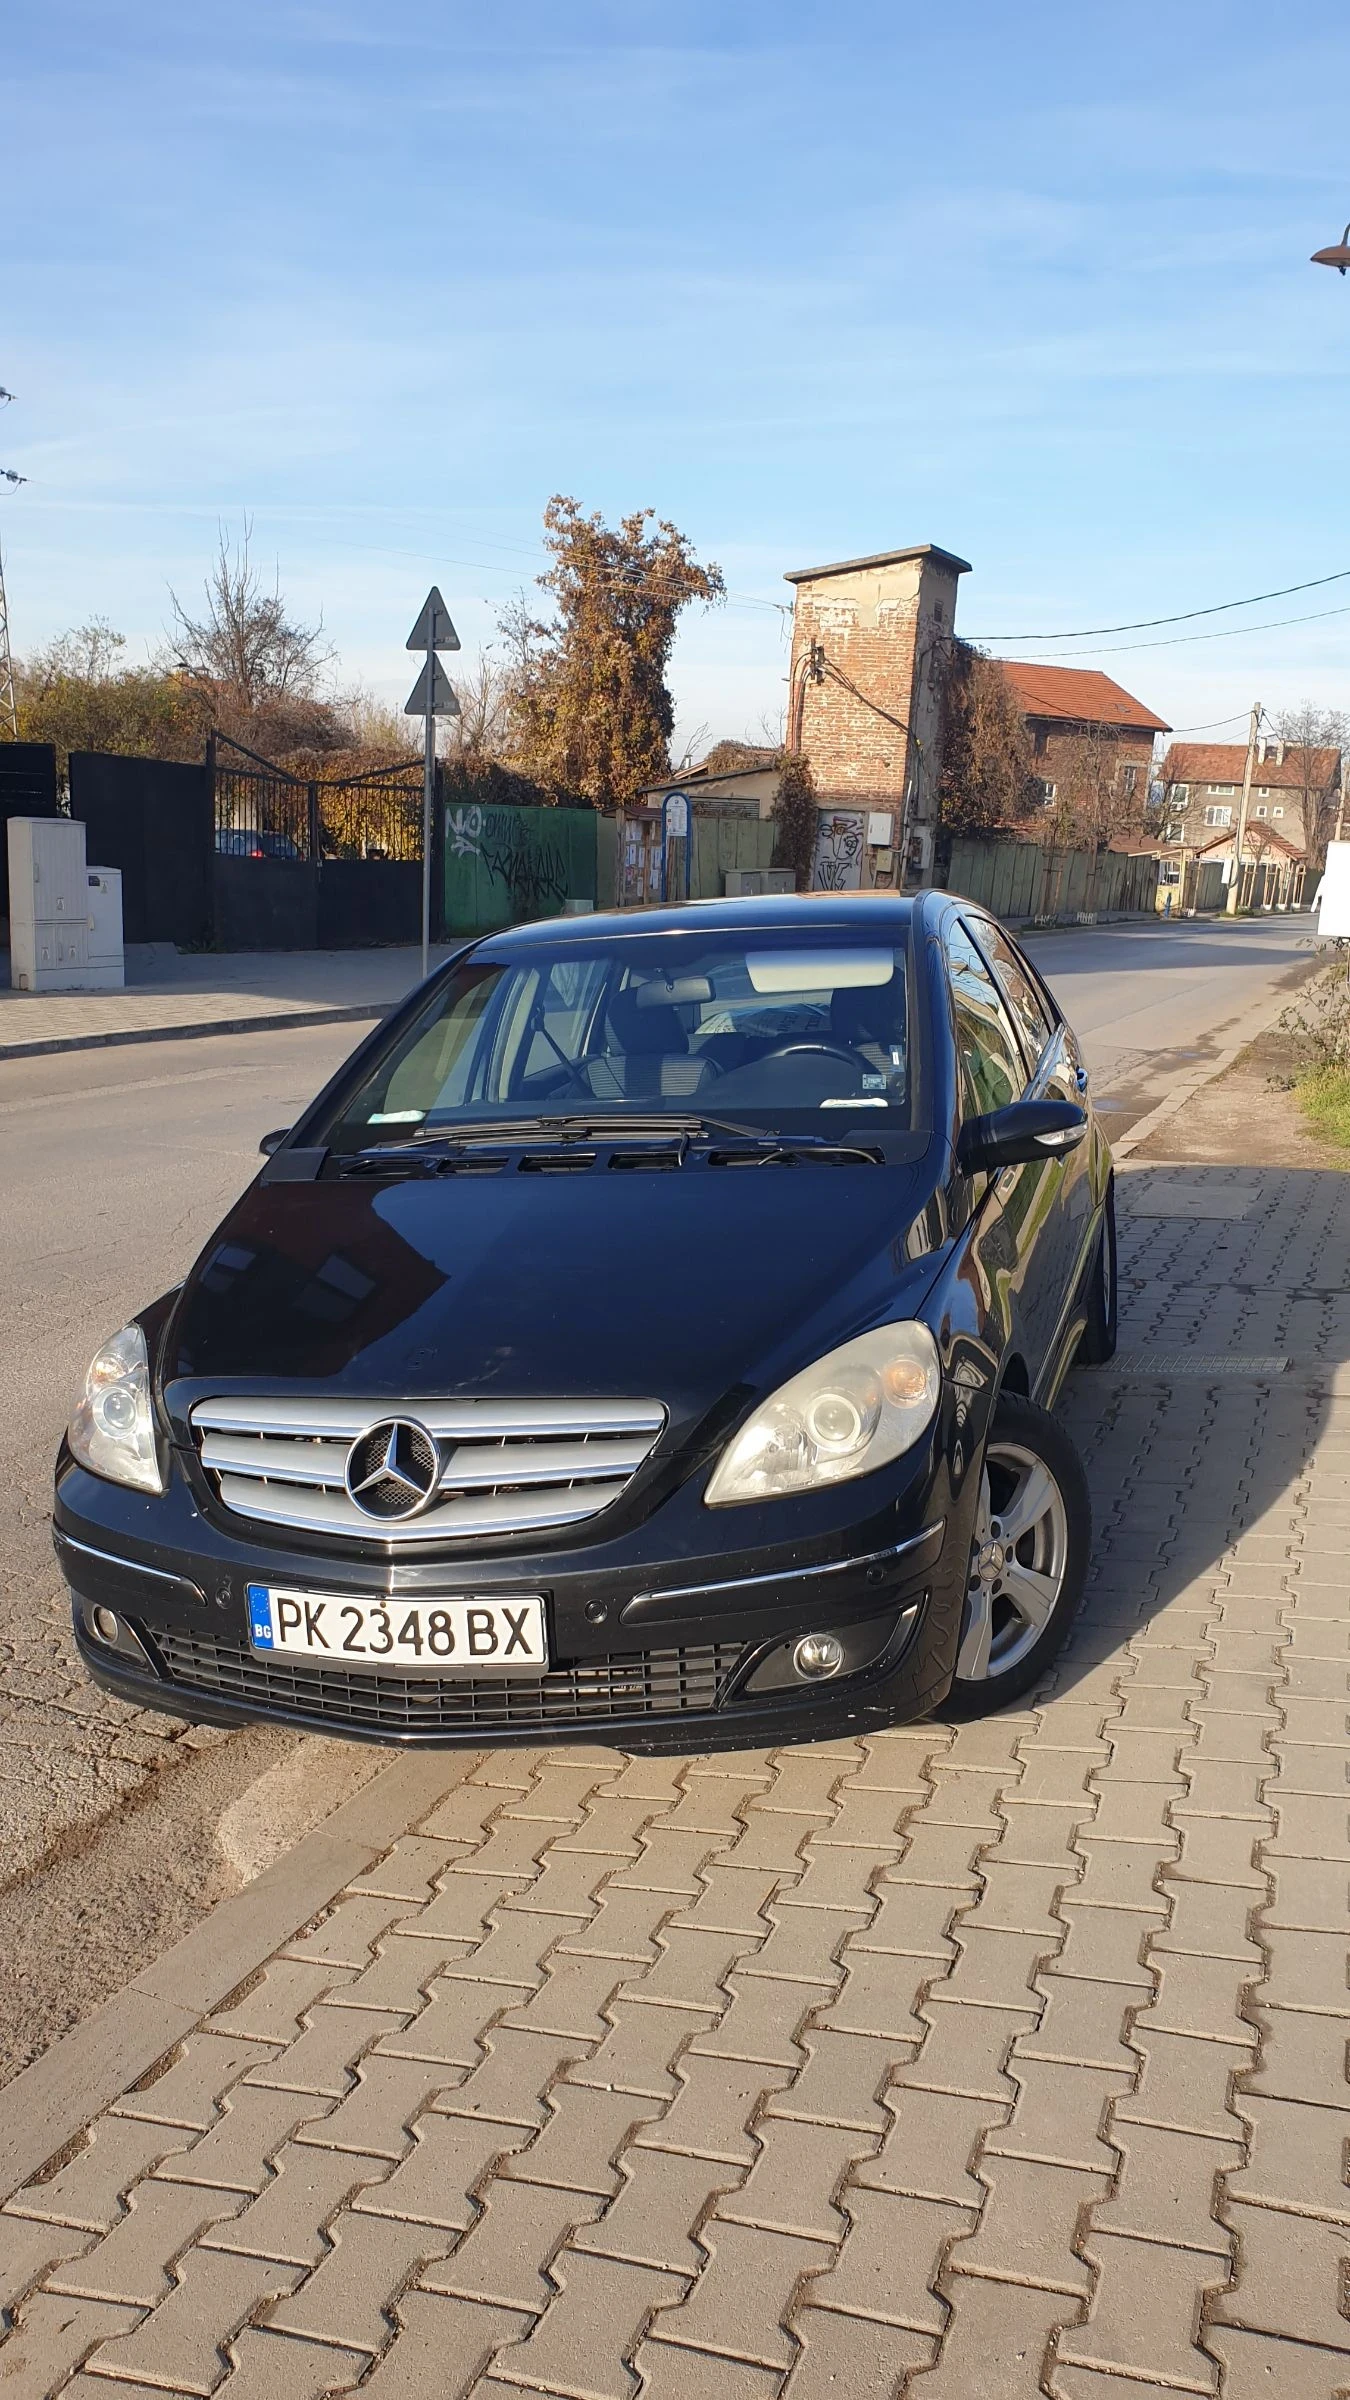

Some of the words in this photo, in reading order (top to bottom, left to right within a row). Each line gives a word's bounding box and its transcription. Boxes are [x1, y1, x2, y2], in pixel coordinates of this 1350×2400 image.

[254, 1623, 272, 1639] BG
[277, 1597, 331, 1649] PK
[340, 1606, 456, 1656] 2348
[466, 1607, 533, 1656] BX
